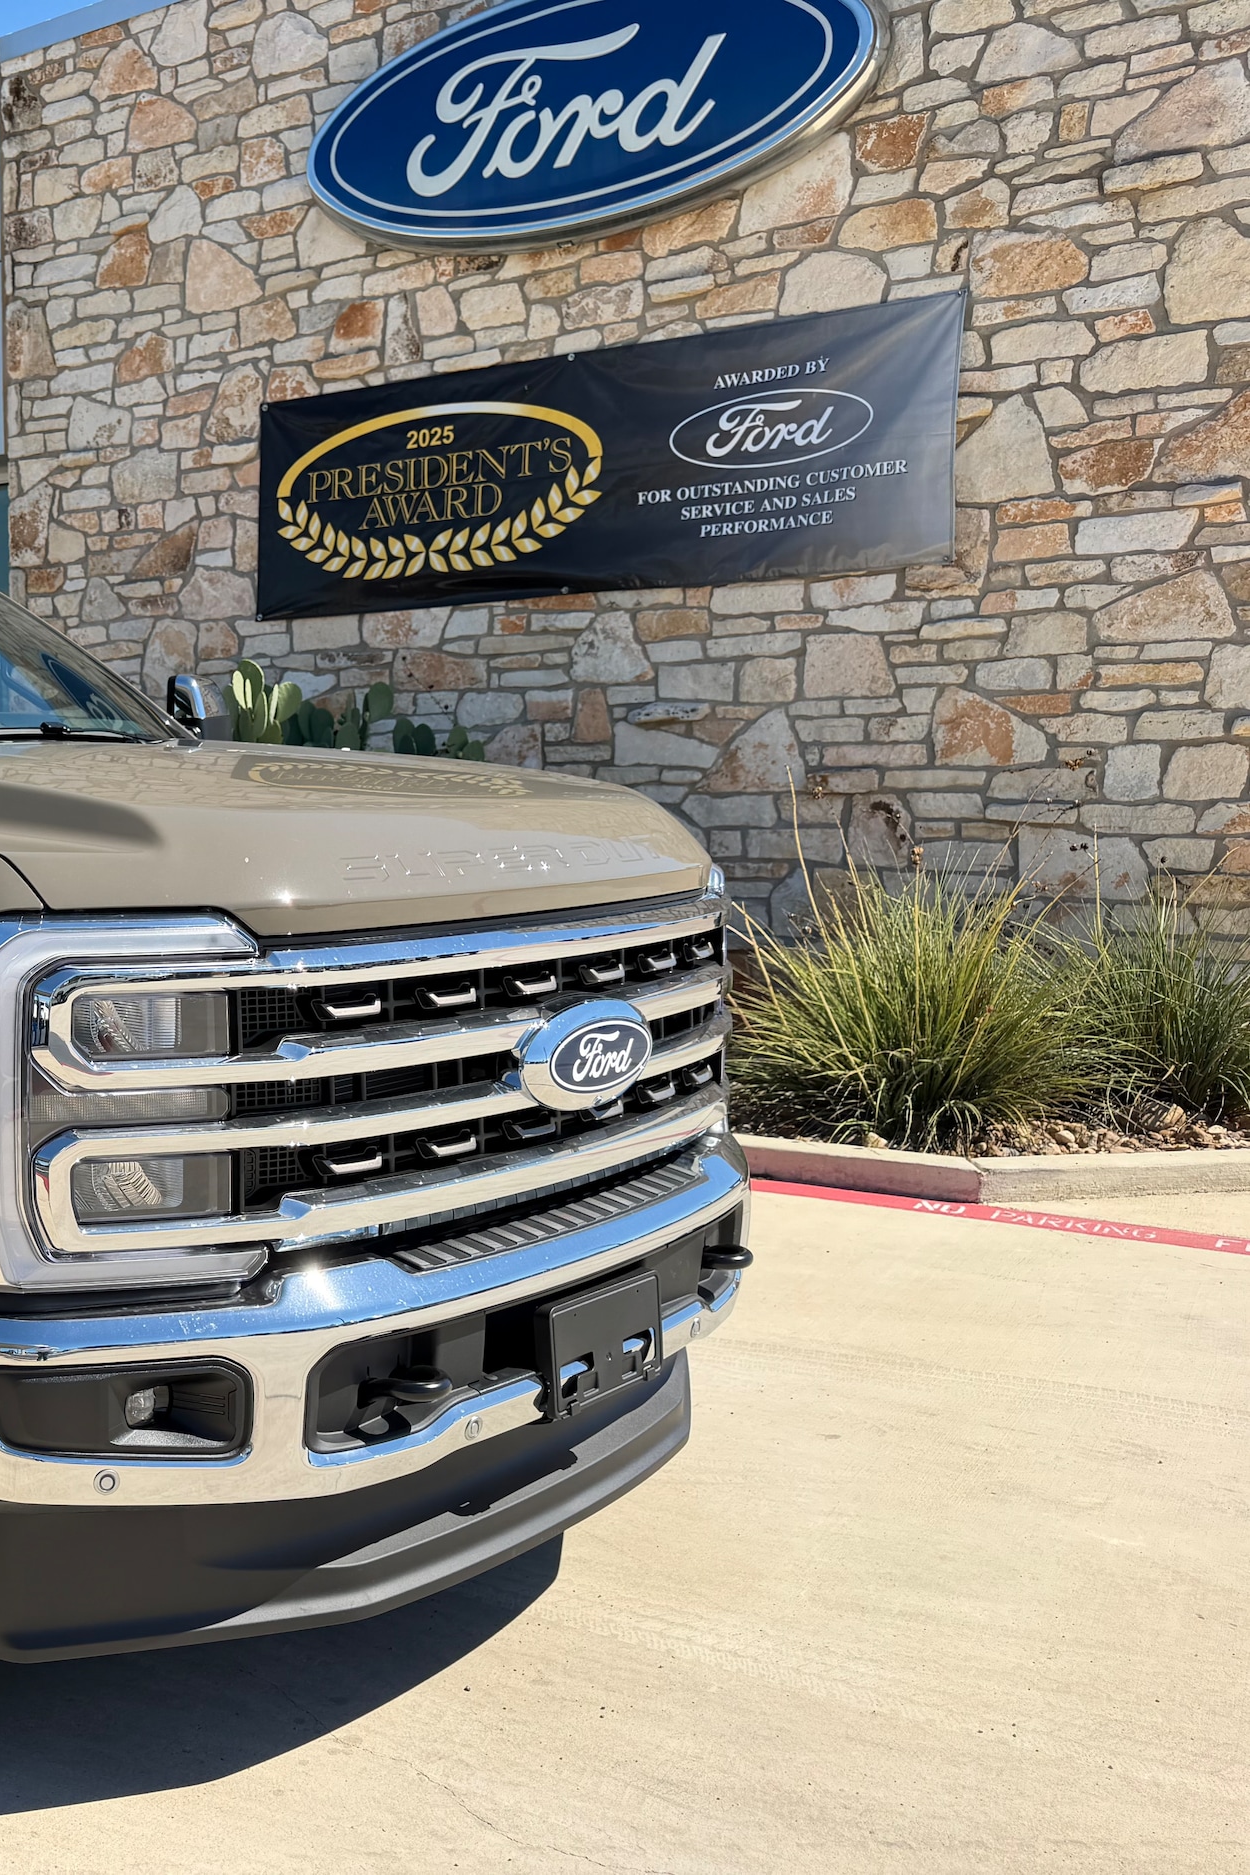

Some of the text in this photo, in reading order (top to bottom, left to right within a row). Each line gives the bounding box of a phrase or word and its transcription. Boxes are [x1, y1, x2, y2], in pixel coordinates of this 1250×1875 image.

[405, 23, 727, 198] Ford
[713, 358, 830, 390] AWARDED BY
[406, 425, 455, 449] 2025
[706, 399, 835, 458] Ford
[307, 437, 572, 503] PRESIDENT'S
[637, 459, 909, 506] FOR OUTSTANDING CUSTOMER
[358, 483, 503, 531] AWARD
[681, 486, 857, 521] SERVICE AND SALES
[699, 510, 834, 538] PERFORMANCE
[572, 1030, 632, 1083] Ford
[912, 1200, 966, 1215] NO
[990, 1209, 1157, 1240] PARKING
